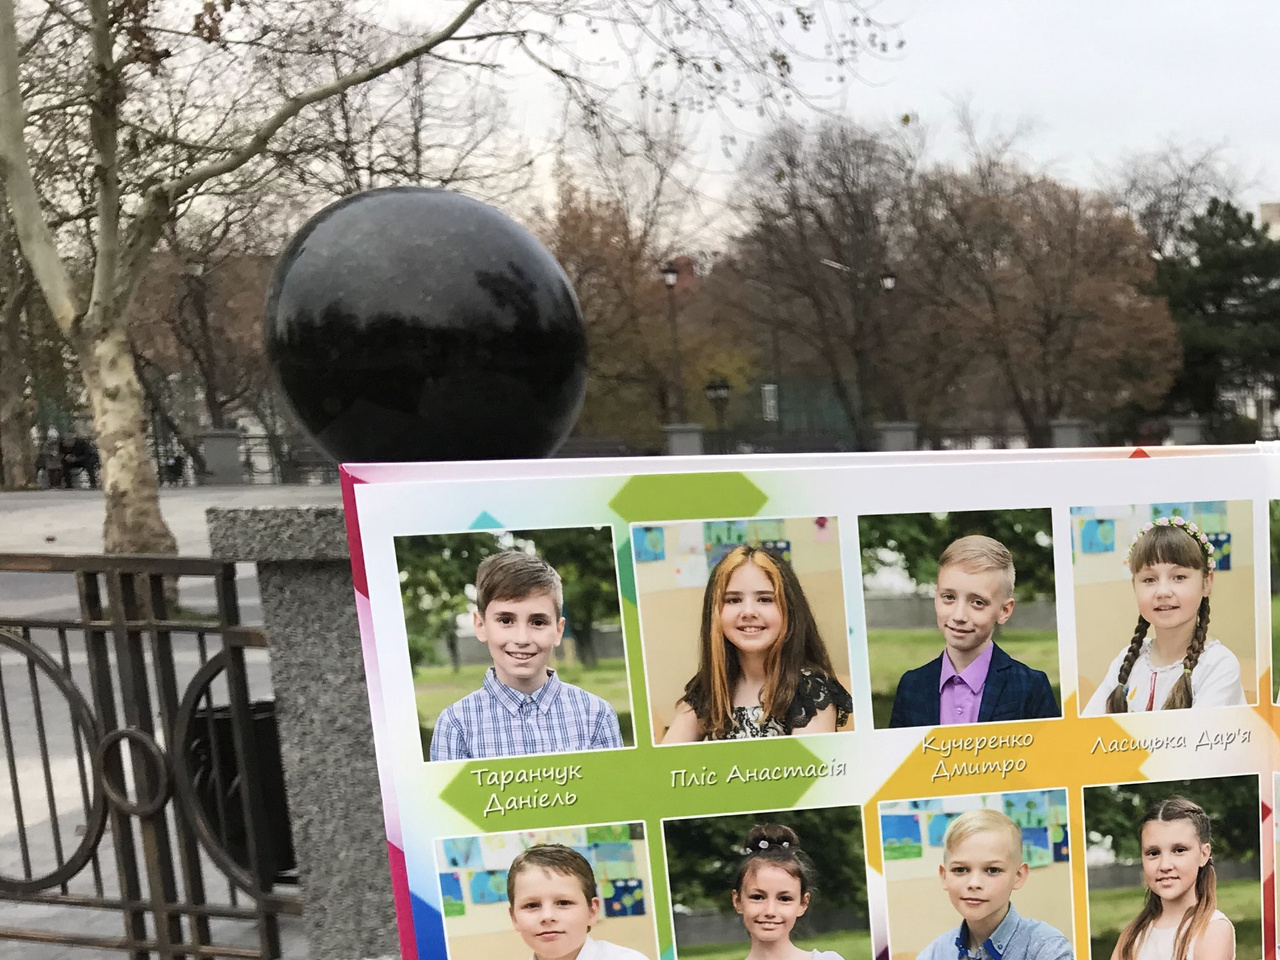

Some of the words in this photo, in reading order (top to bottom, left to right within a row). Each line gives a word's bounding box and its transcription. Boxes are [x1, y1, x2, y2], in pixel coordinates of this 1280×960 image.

[921, 732, 1034, 758] Кучеренко
[1090, 734, 1186, 755] Ласицька
[470, 764, 583, 789] Таранчук
[670, 769, 718, 788] Пліс
[725, 758, 847, 784] Анастасія
[931, 756, 1027, 782] Дмитро
[483, 788, 578, 817] Даніель
